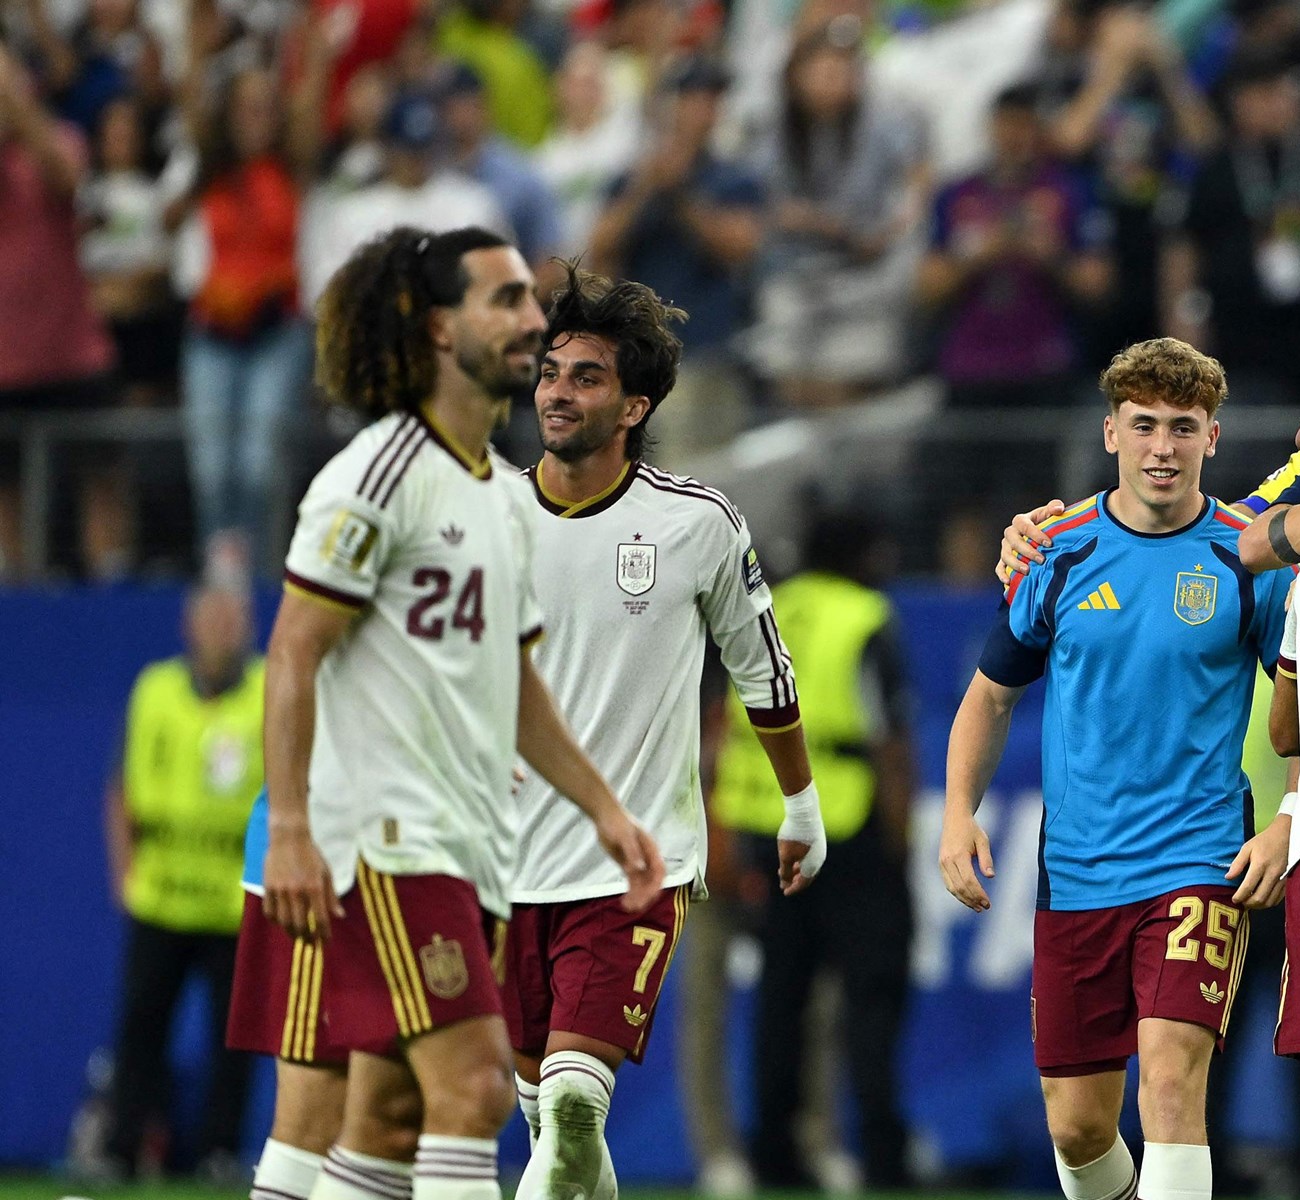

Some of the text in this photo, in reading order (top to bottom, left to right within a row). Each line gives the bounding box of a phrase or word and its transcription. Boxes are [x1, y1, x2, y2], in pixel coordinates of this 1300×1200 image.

[407, 566, 485, 642] 24
[632, 925, 667, 995] 7
[1165, 895, 1240, 972] 25
